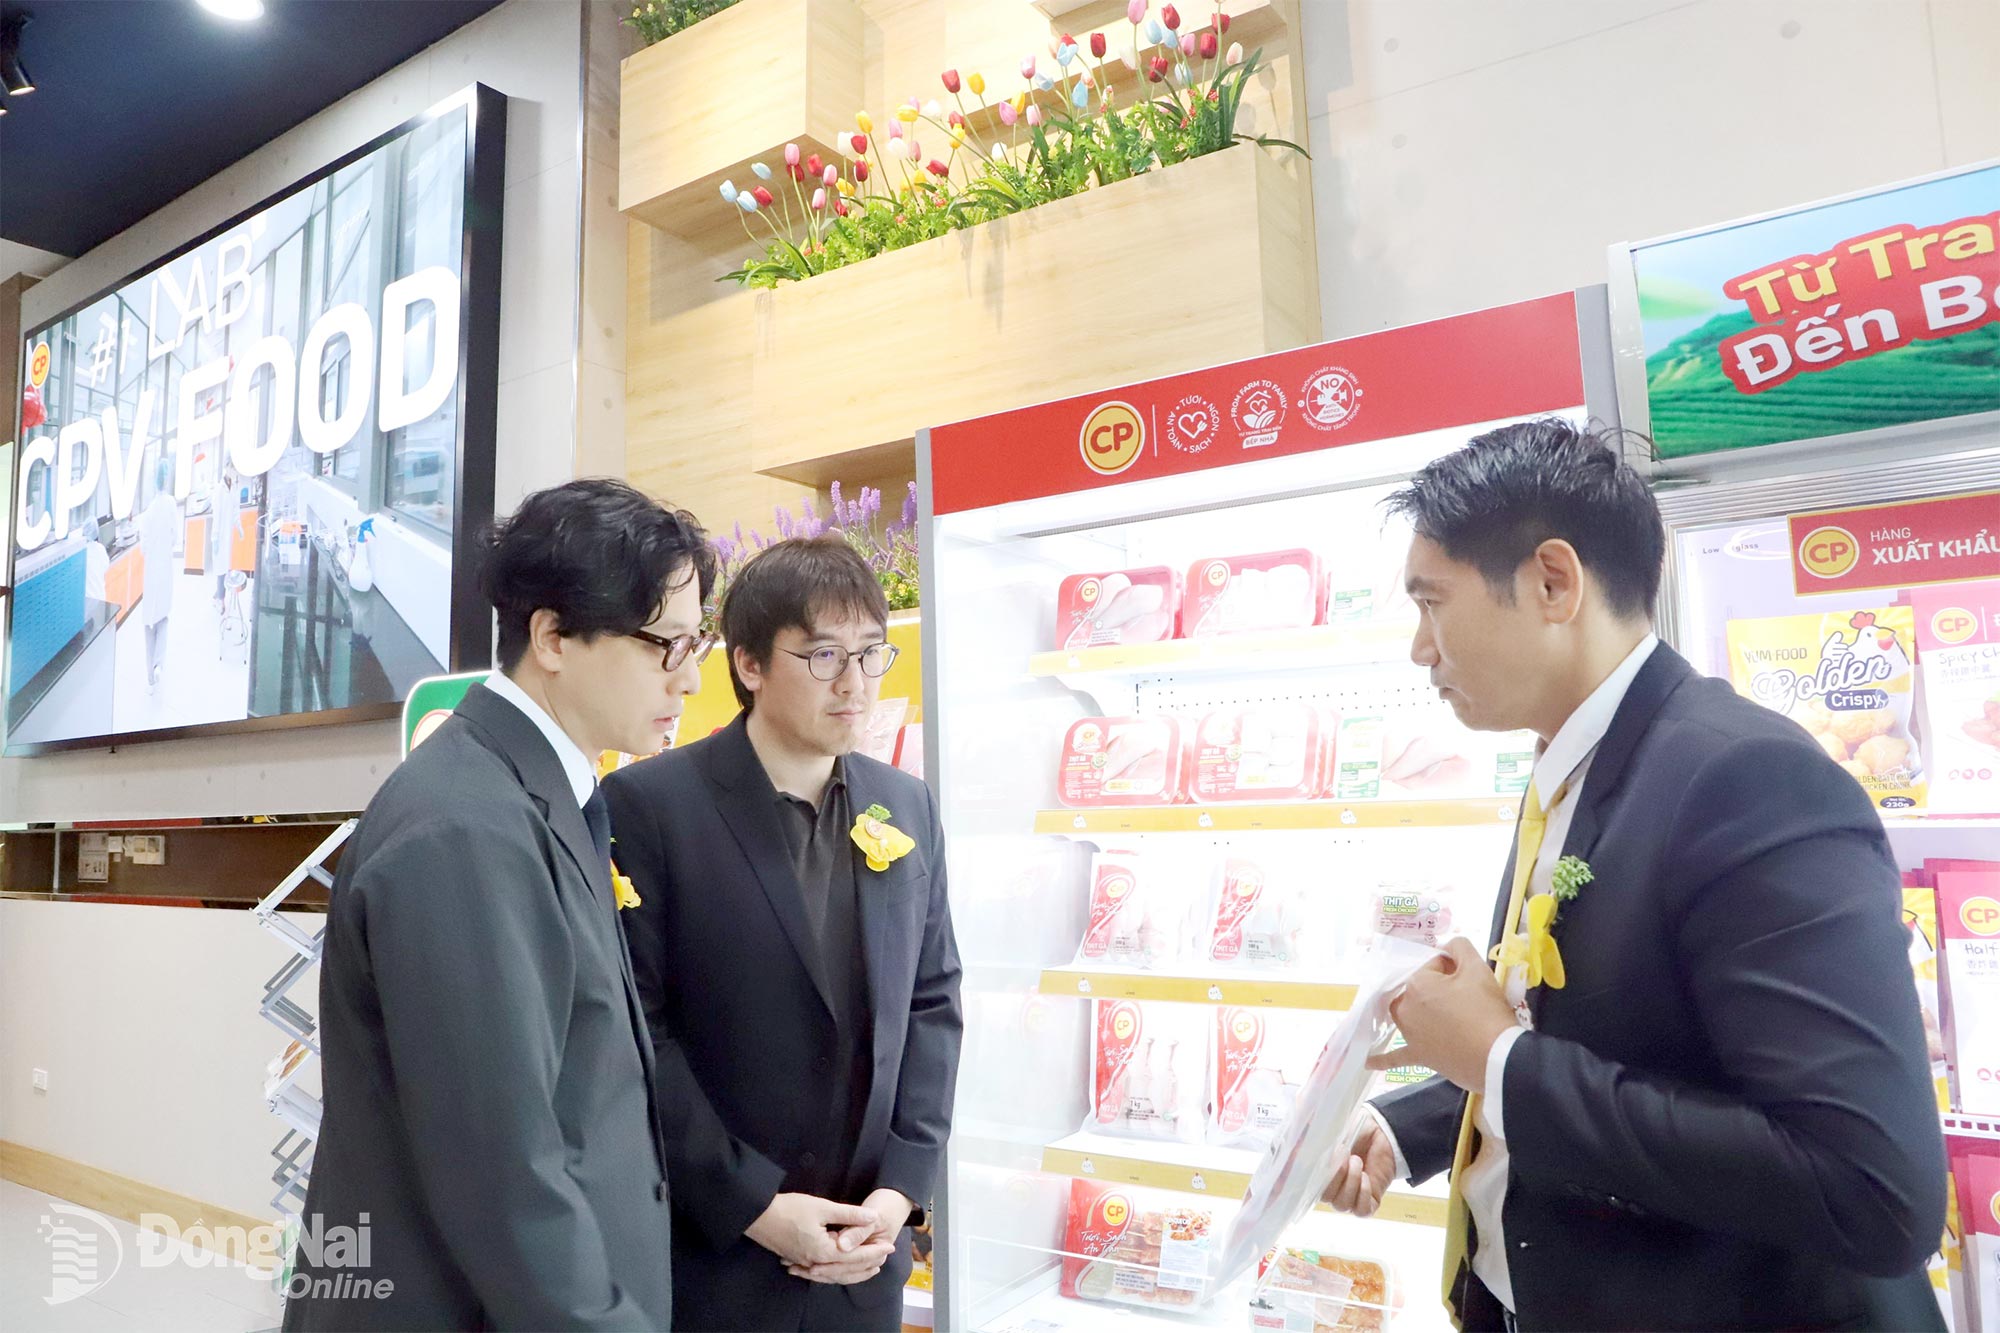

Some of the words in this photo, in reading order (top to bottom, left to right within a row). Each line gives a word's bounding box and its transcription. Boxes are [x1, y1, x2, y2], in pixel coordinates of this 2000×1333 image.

[1738, 256, 1838, 316] Từ
[1849, 219, 2000, 280] Tra
[148, 233, 253, 359] LAB
[1733, 303, 1901, 386] Đến
[1920, 275, 2000, 331] B
[1320, 377, 1340, 390] NO
[16, 390, 154, 551] CPV
[174, 266, 461, 501] FOOD
[1230, 395, 1242, 418] FROM
[1239, 380, 1260, 396] FARM
[1261, 379, 1272, 388] TO
[1271, 383, 1288, 409] FAMILY
[1166, 410, 1177, 425] AN
[1206, 402, 1220, 432] NGON
[1089, 422, 1134, 455] CP
[1870, 527, 1912, 542] HÀNG
[1809, 542, 1849, 564] CP
[1872, 538, 1933, 565] XUẤT
[1937, 616, 1970, 633] CP
[1775, 647, 1808, 661] FOOD
[1751, 651, 1893, 716] Golden
[1831, 693, 1882, 710] Crispy
[1966, 907, 2000, 924] CP
[1107, 1205, 1124, 1217] CP
